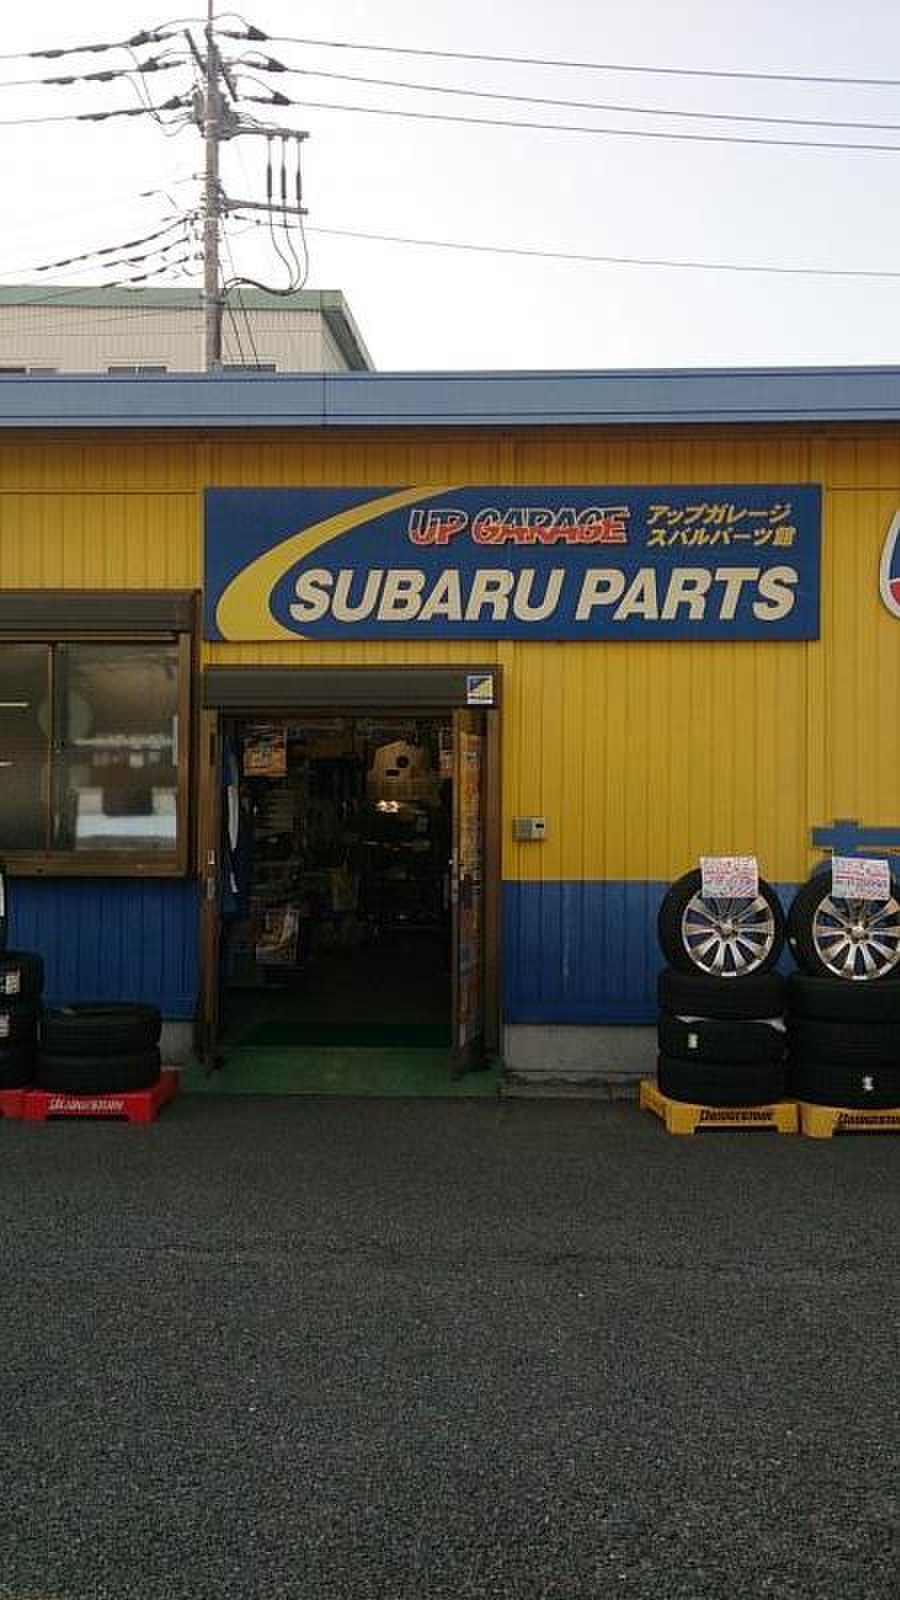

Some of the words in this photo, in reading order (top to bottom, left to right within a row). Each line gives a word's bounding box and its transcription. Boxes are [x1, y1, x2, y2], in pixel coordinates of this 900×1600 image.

[408, 507, 466, 547] UP
[470, 504, 629, 546] GARAGE
[646, 502, 793, 525] アップガレージ
[289, 566, 564, 623] SUBARU
[574, 566, 799, 623] PARTS
